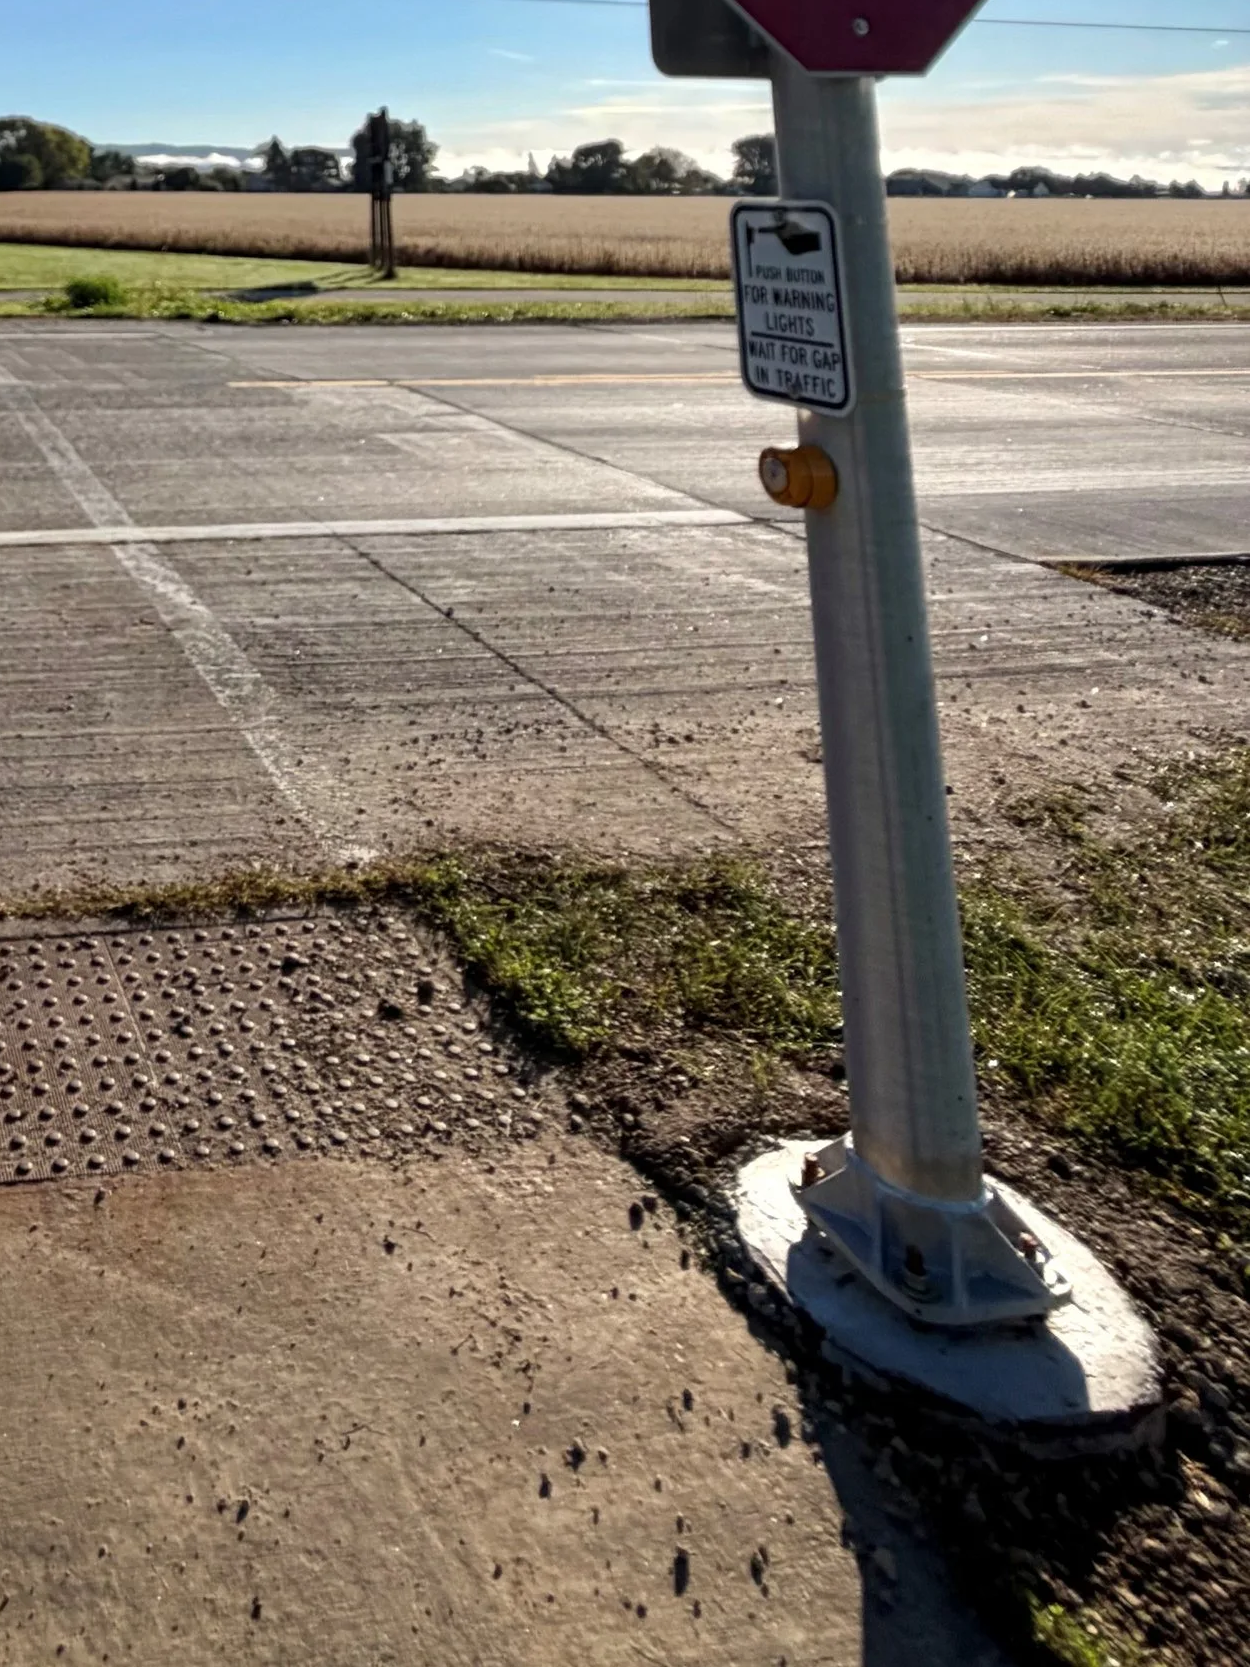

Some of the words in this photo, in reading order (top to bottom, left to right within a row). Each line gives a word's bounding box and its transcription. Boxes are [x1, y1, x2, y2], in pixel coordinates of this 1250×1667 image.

[756, 265, 781, 279] PUSH
[786, 268, 825, 284] BUTTON
[744, 284, 768, 305] FOR
[773, 288, 835, 312] WARNING
[766, 311, 814, 337] LIGHTS
[749, 341, 775, 361] WAIT
[781, 344, 808, 366] FOR
[813, 349, 840, 371] GAP
[755, 365, 769, 384] IN
[776, 368, 836, 398] TRAFFIC
